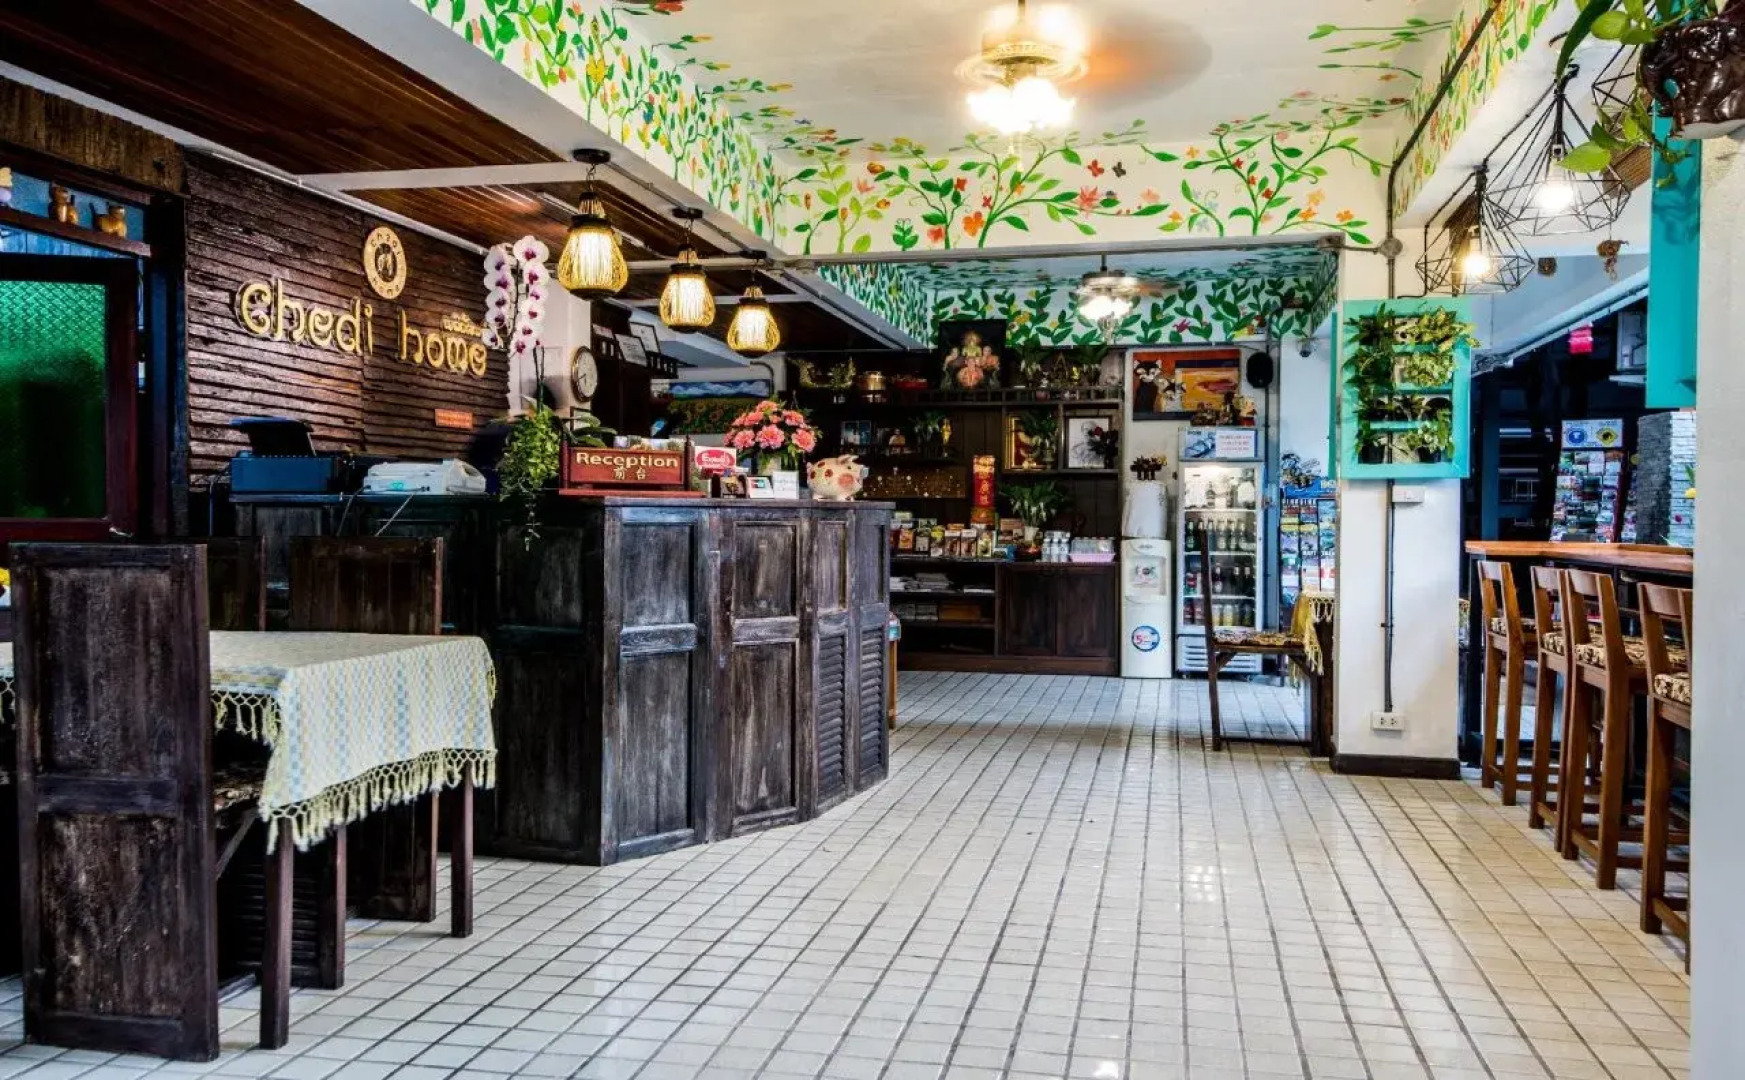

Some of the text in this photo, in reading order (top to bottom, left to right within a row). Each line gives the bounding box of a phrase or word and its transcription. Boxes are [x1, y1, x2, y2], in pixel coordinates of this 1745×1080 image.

[399, 308, 488, 376] home
[576, 452, 679, 469] Reception
[613, 465, 646, 481] 前台
